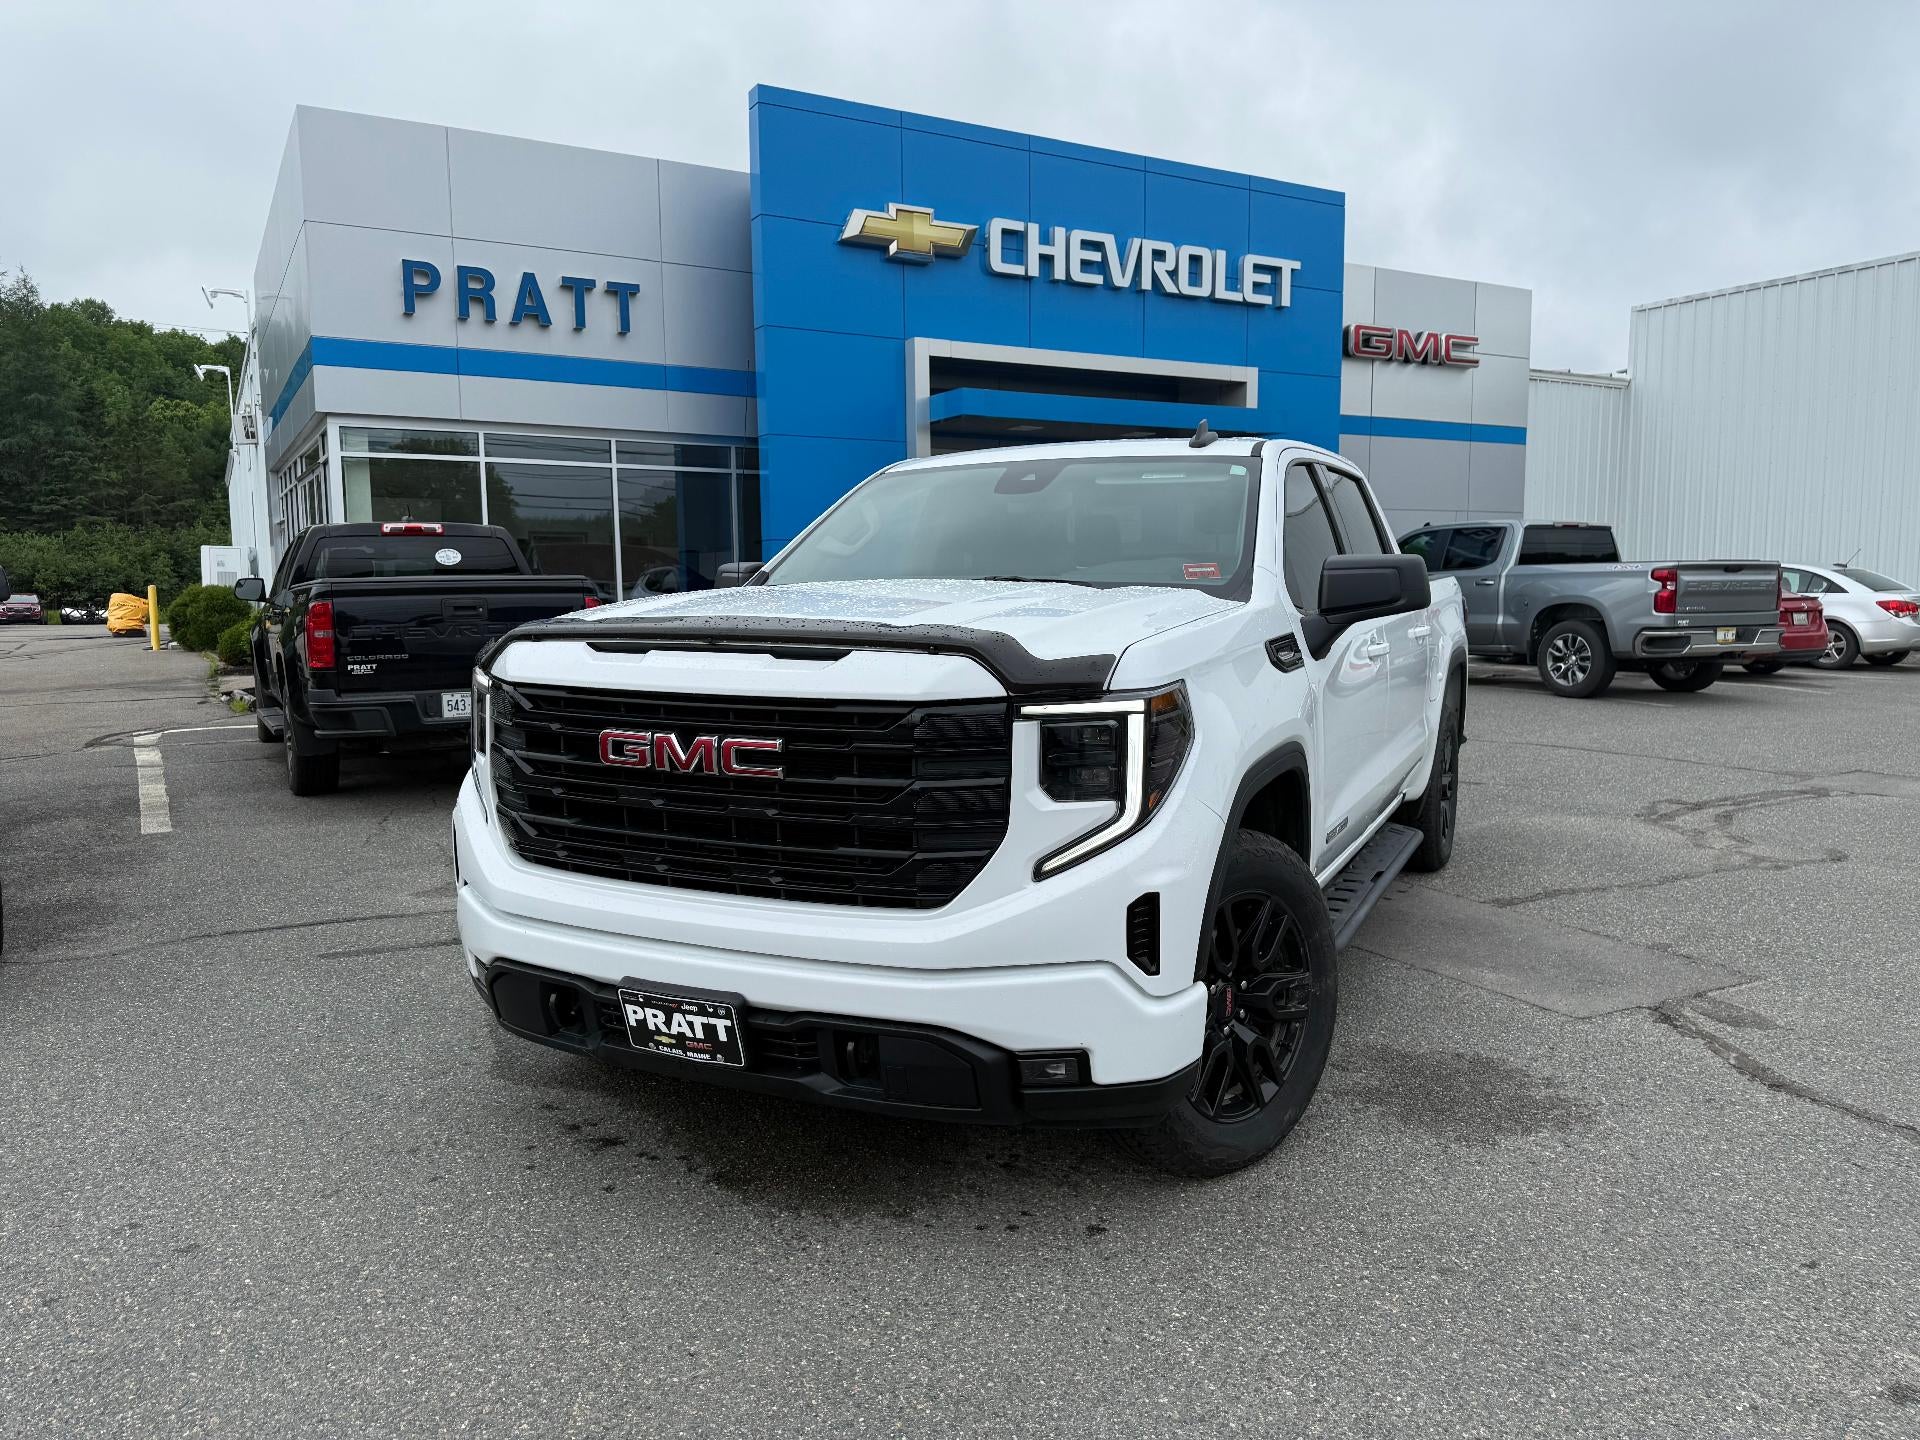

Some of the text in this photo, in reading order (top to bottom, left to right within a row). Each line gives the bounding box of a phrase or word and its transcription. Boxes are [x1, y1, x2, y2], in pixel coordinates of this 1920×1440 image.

[985, 216, 1301, 308] CHEVROLET
[401, 258, 641, 336] PRATT
[1343, 322, 1480, 368] GMC
[346, 653, 409, 661] COLORADO
[347, 663, 378, 671] PRATT
[599, 728, 784, 780] GMC
[680, 1002, 698, 1013] Jeep
[624, 1003, 732, 1042] PRATT
[685, 1040, 713, 1050] GMC
[686, 1051, 712, 1060] MAINE
